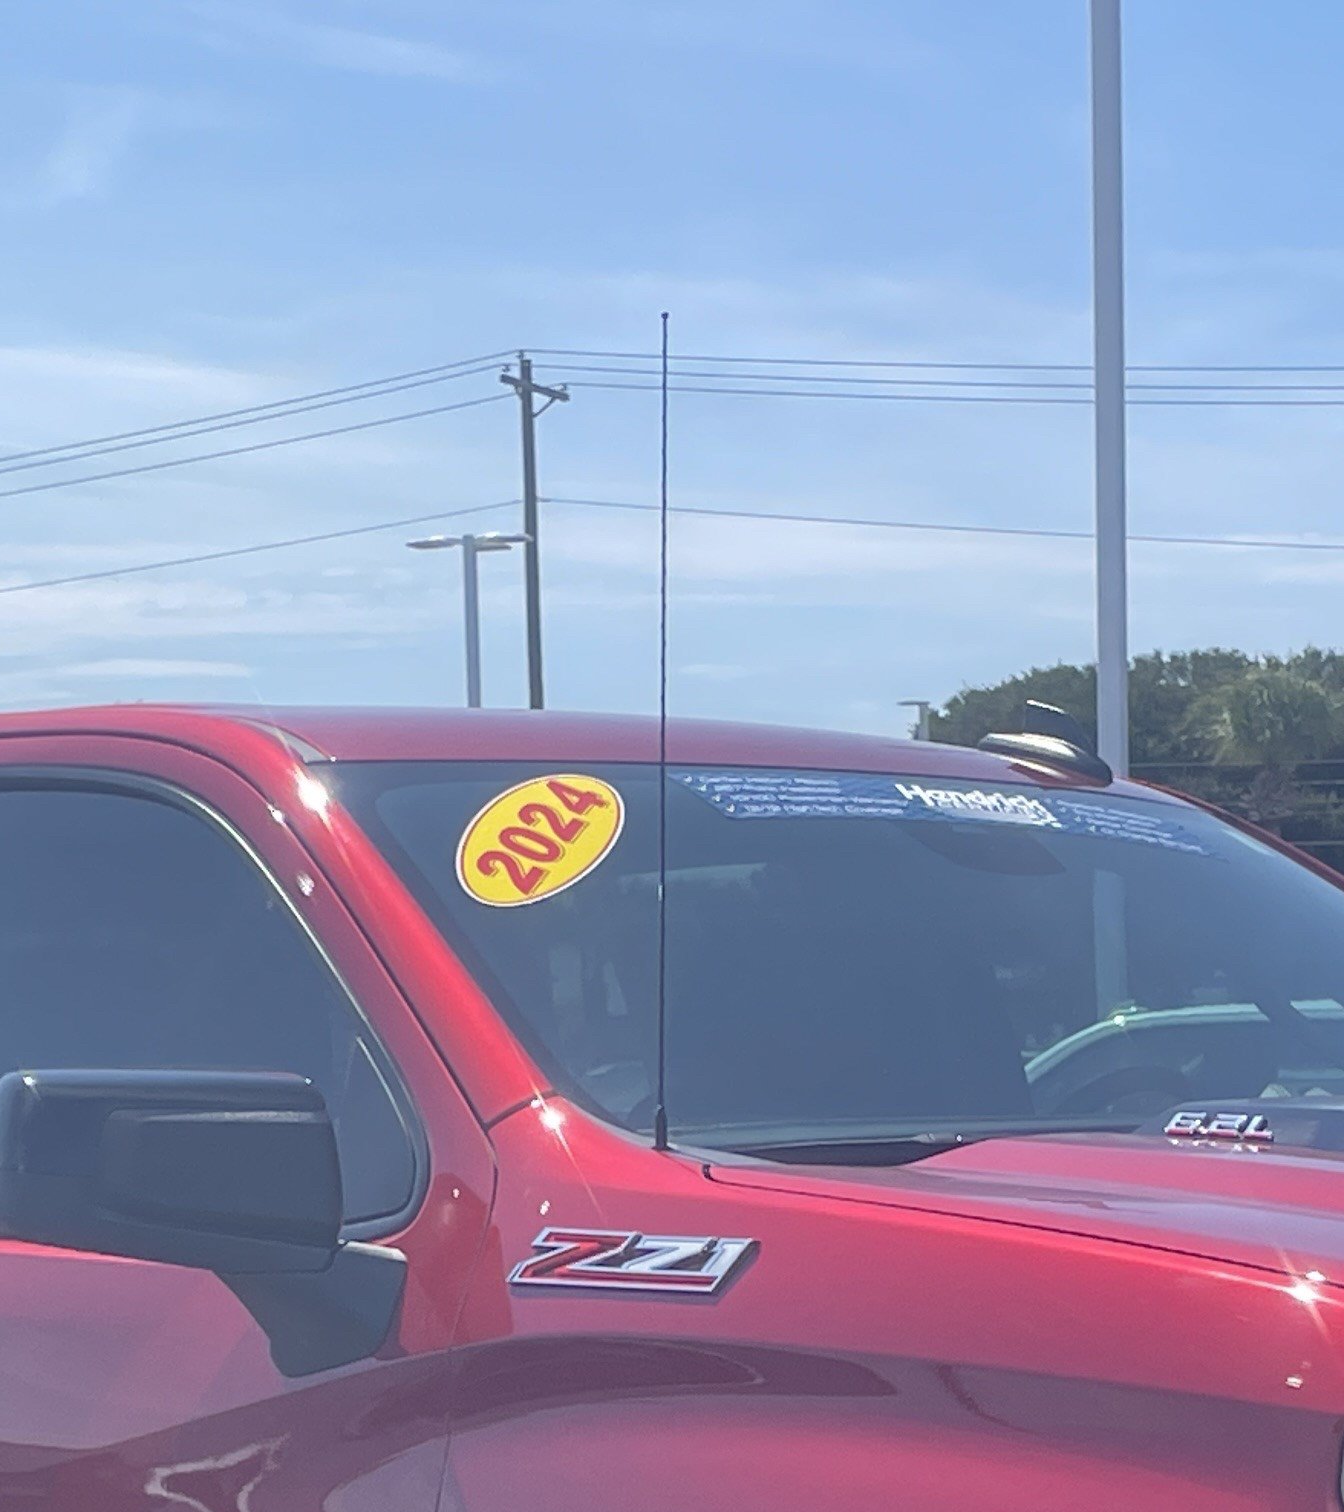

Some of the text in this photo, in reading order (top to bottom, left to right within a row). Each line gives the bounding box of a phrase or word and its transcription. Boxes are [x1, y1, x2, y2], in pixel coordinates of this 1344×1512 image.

[894, 784, 1062, 828] Hendrick
[477, 780, 608, 895] 2024
[1164, 1111, 1273, 1142] 6.2L
[505, 1226, 758, 1293] Z71
